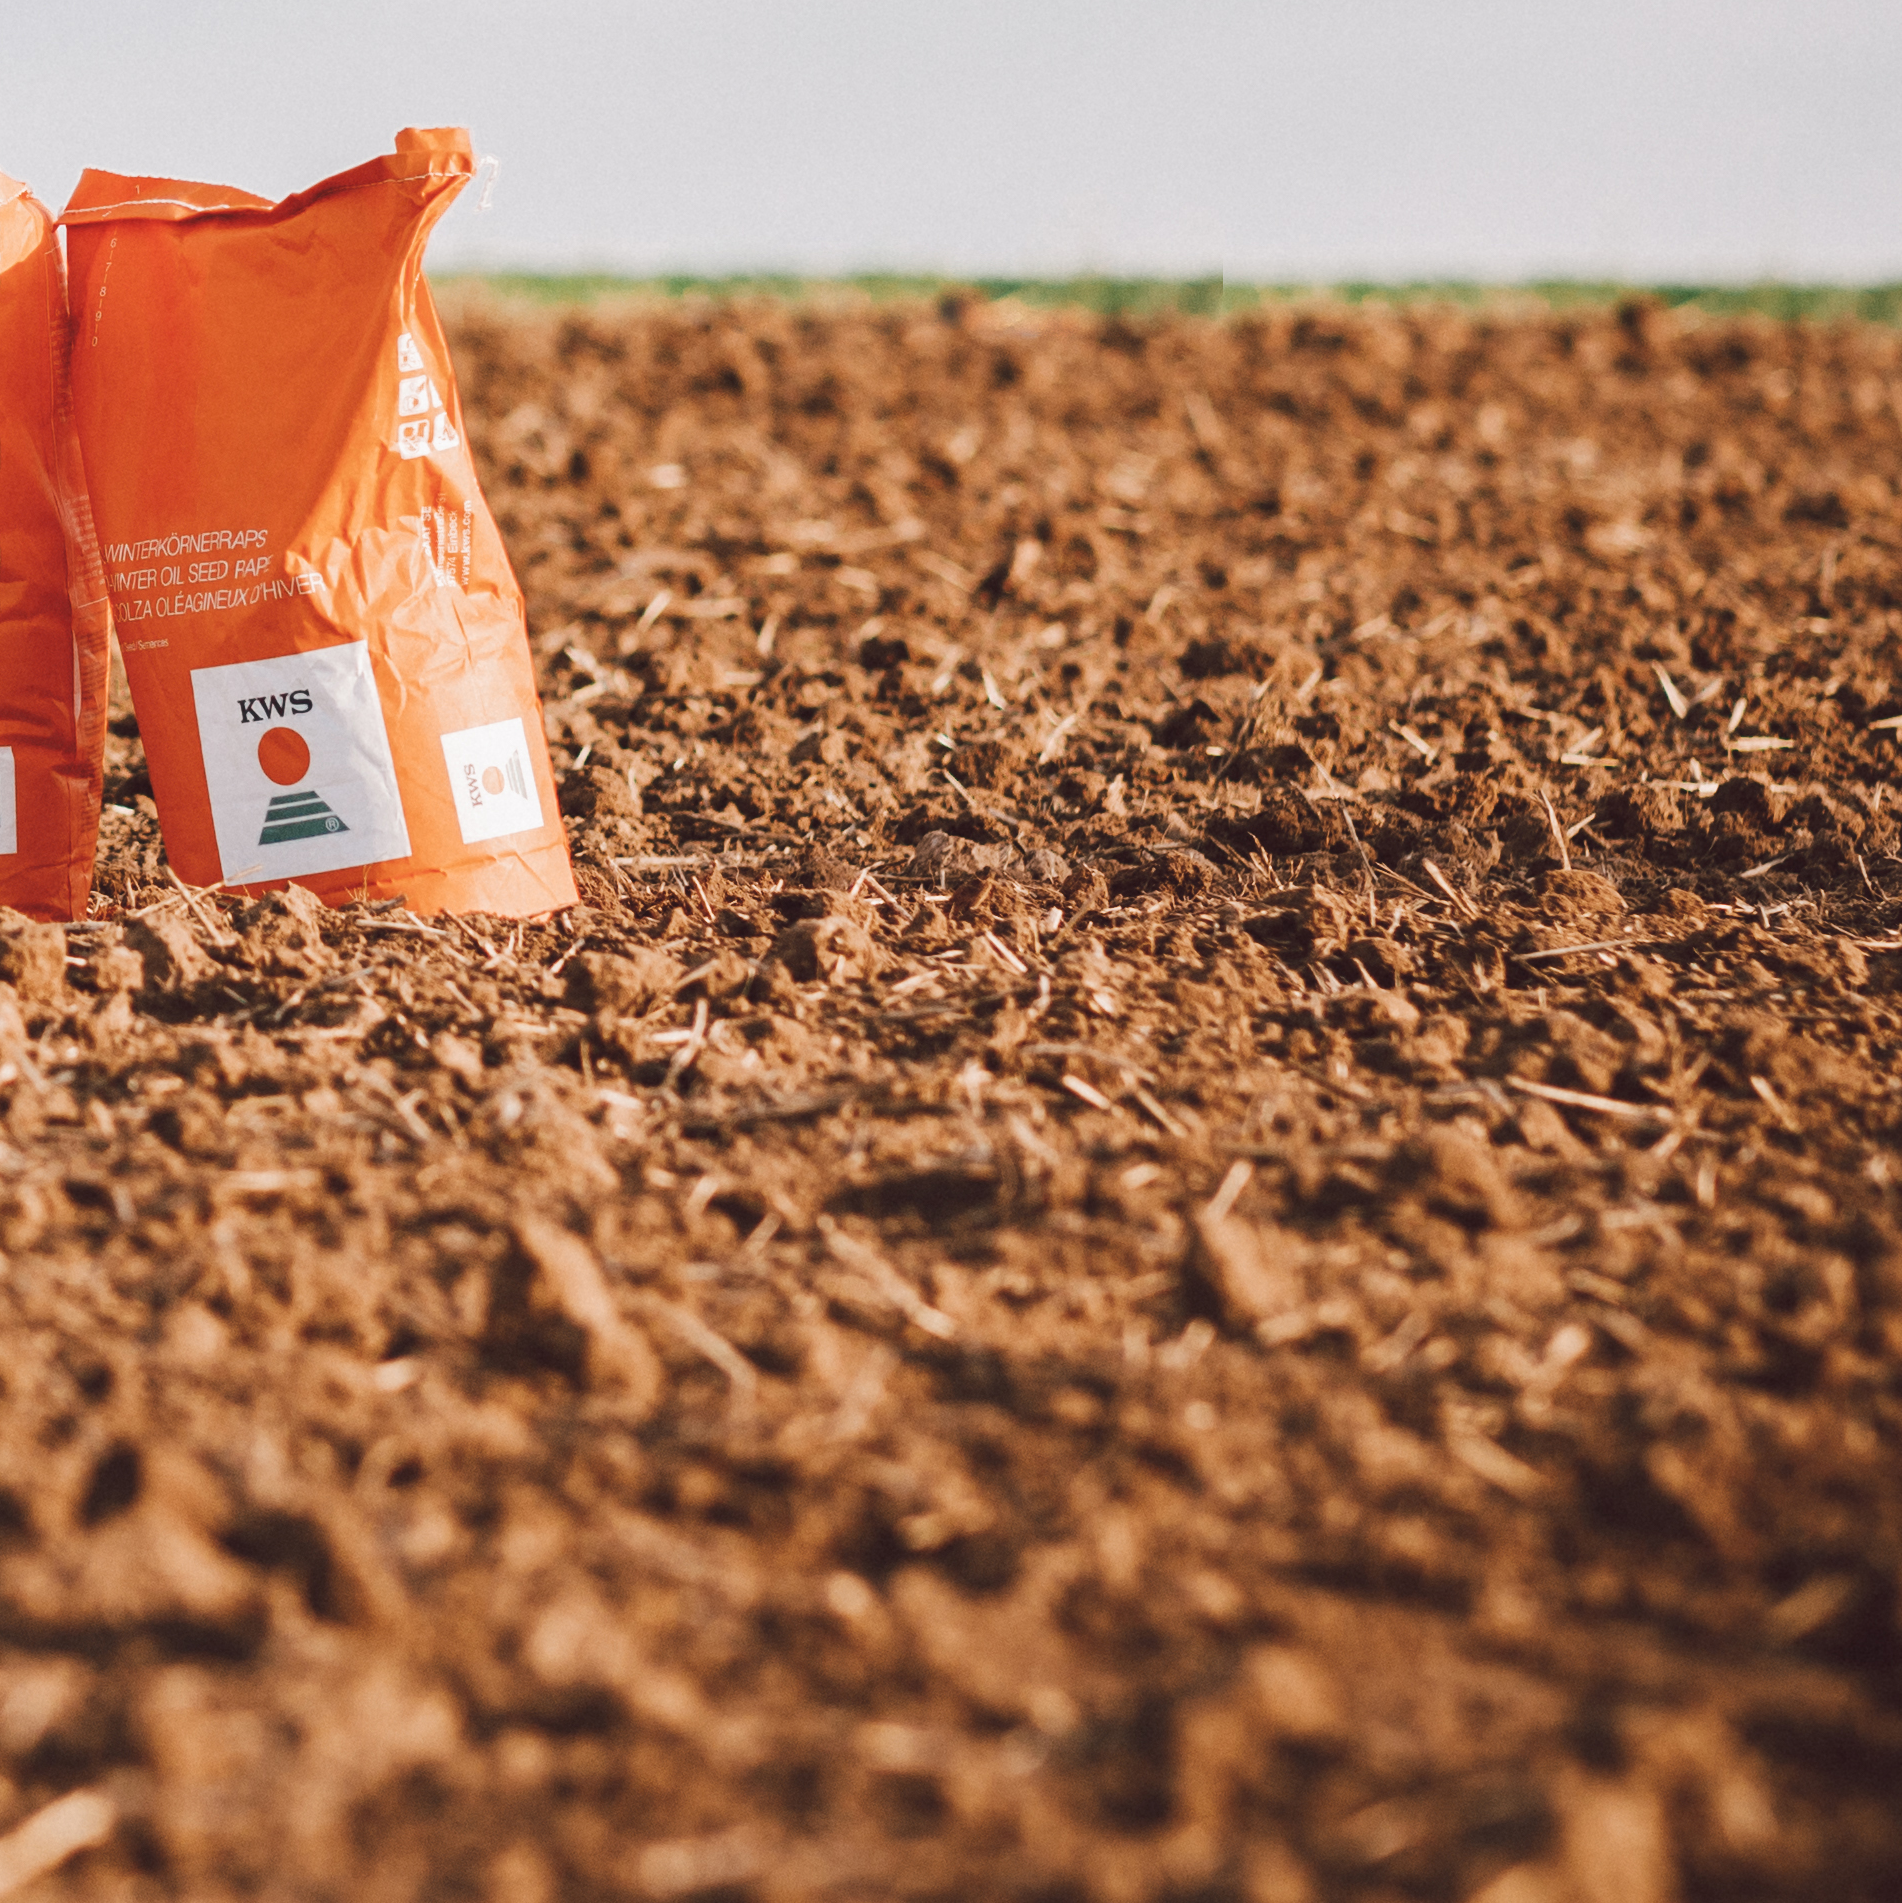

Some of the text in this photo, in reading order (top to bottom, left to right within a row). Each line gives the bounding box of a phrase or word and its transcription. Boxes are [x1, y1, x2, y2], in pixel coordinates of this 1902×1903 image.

[460, 500, 472, 585] www.kws.com
[155, 588, 250, 617] OLÉAGINEUX
[249, 572, 327, 605] D'HIVER
[160, 566, 184, 587] OIL
[188, 560, 229, 584] SEED
[237, 689, 313, 724] KWS
[463, 763, 483, 808] KWS
